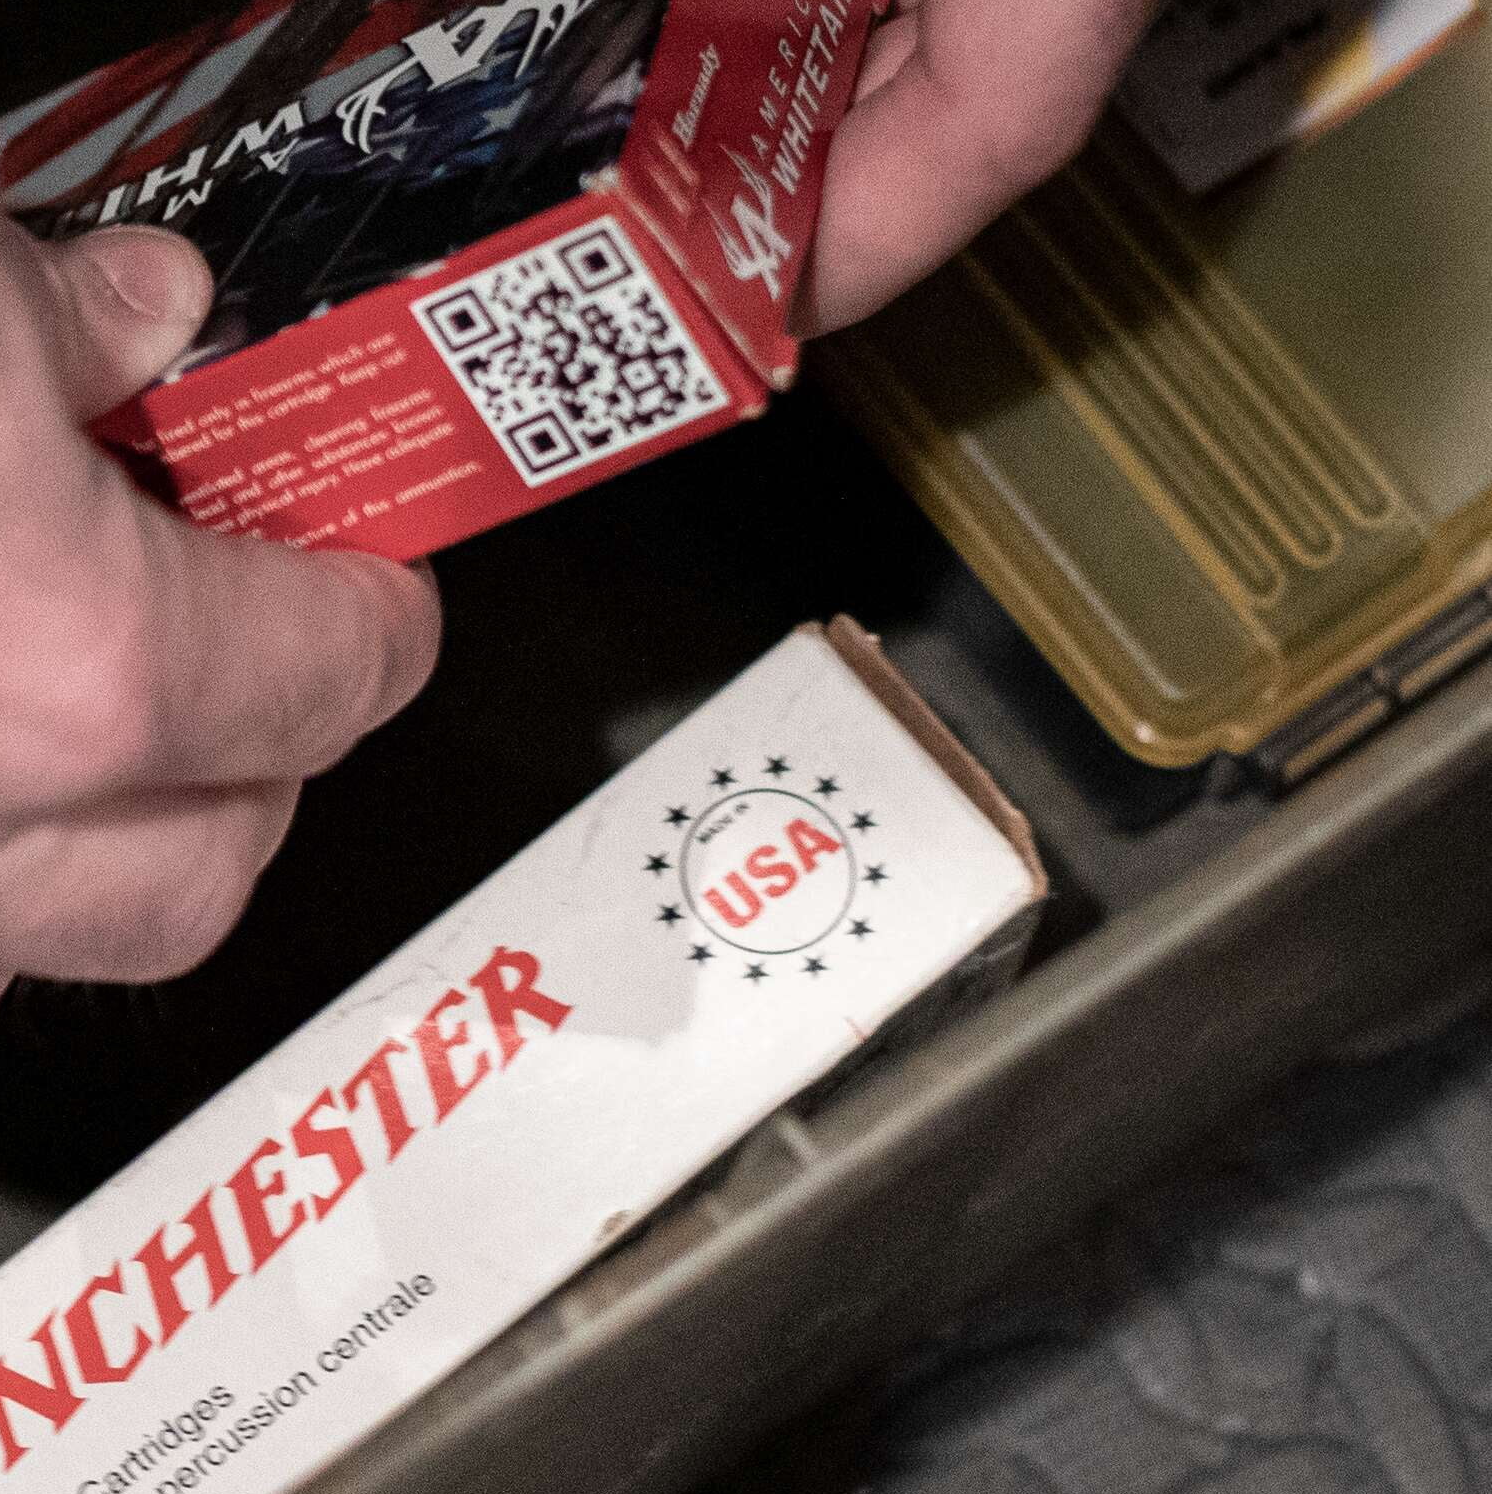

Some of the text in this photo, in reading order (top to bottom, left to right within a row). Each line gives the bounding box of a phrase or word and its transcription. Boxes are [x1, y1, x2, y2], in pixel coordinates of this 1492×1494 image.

[671, 42, 721, 152] Hornady
[197, 407, 233, 429] only
[318, 346, 365, 375] which
[212, 424, 235, 442] for
[234, 482, 263, 504] and
[268, 467, 305, 489] other
[342, 508, 360, 528] of
[362, 499, 391, 518] this
[703, 818, 843, 928] USA
[317, 1274, 436, 1372] centrale
